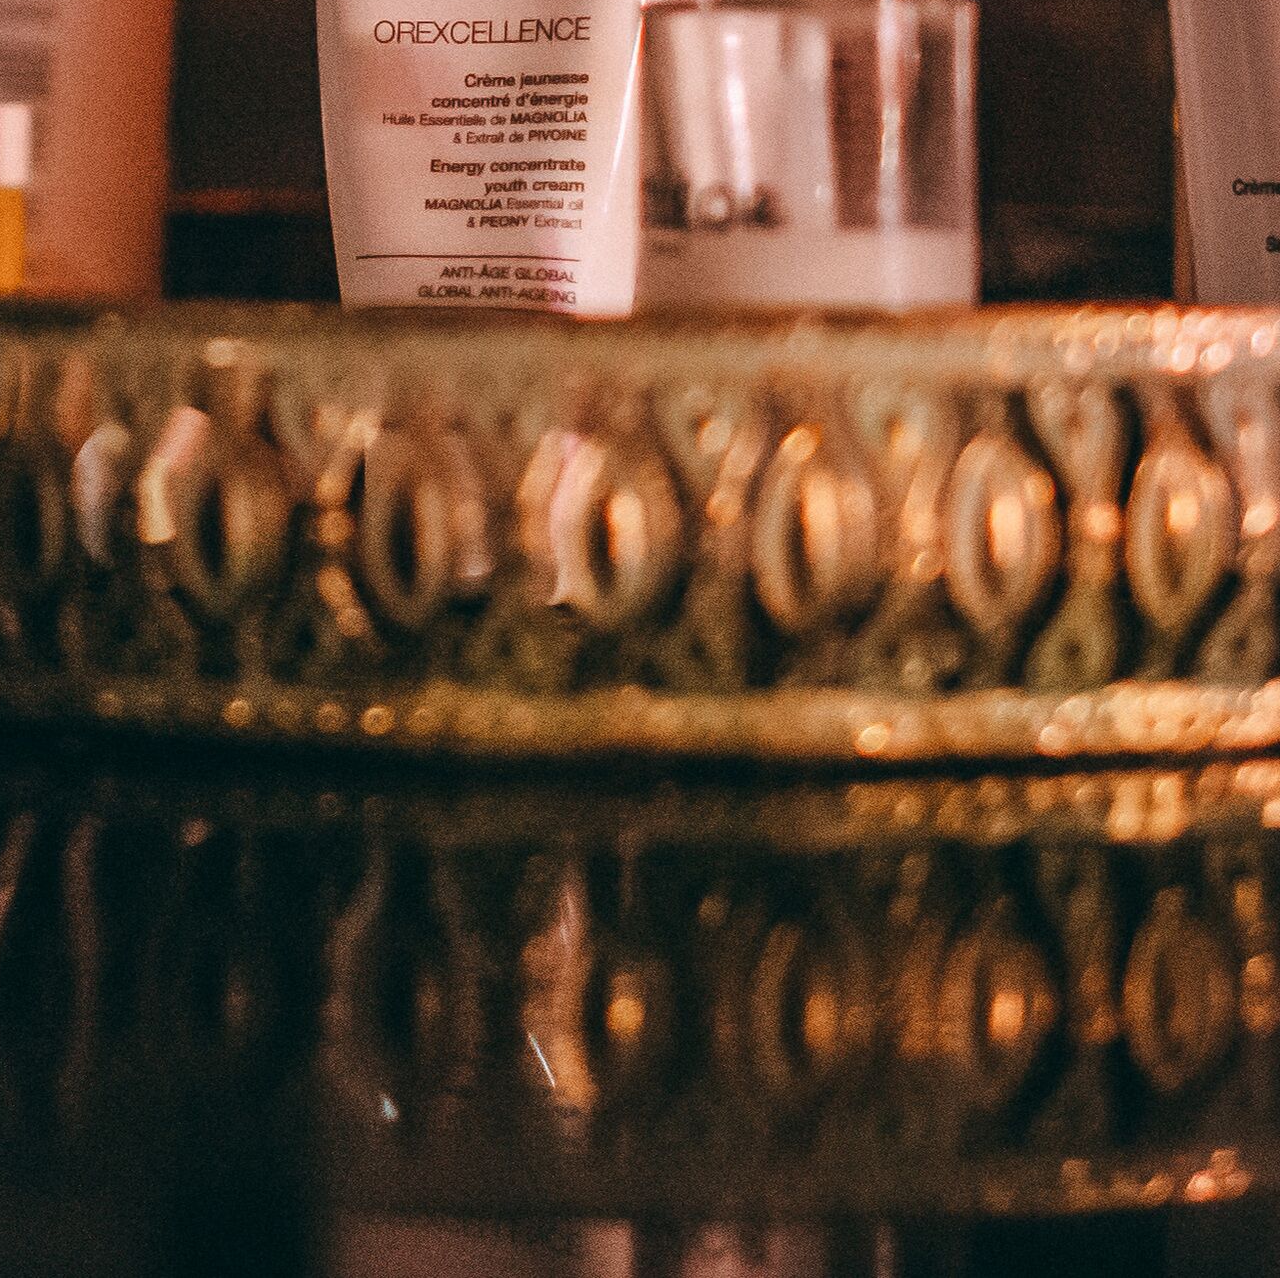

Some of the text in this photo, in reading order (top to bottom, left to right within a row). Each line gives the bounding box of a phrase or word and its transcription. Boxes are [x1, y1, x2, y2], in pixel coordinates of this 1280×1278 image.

[374, 16, 591, 44] OREXCELLENCE
[464, 72, 589, 89] Crème jeunesse
[431, 92, 510, 108] concentré
[419, 113, 486, 127] Essentielle
[490, 113, 507, 126] de
[510, 112, 587, 125] MAGNOLIA
[453, 129, 587, 144] & Extrait de PIVOINE
[430, 159, 586, 177] Energy concentrate
[484, 179, 585, 196] youth cream
[424, 199, 503, 211] MAGNOLIA
[479, 216, 529, 229] PEONY
